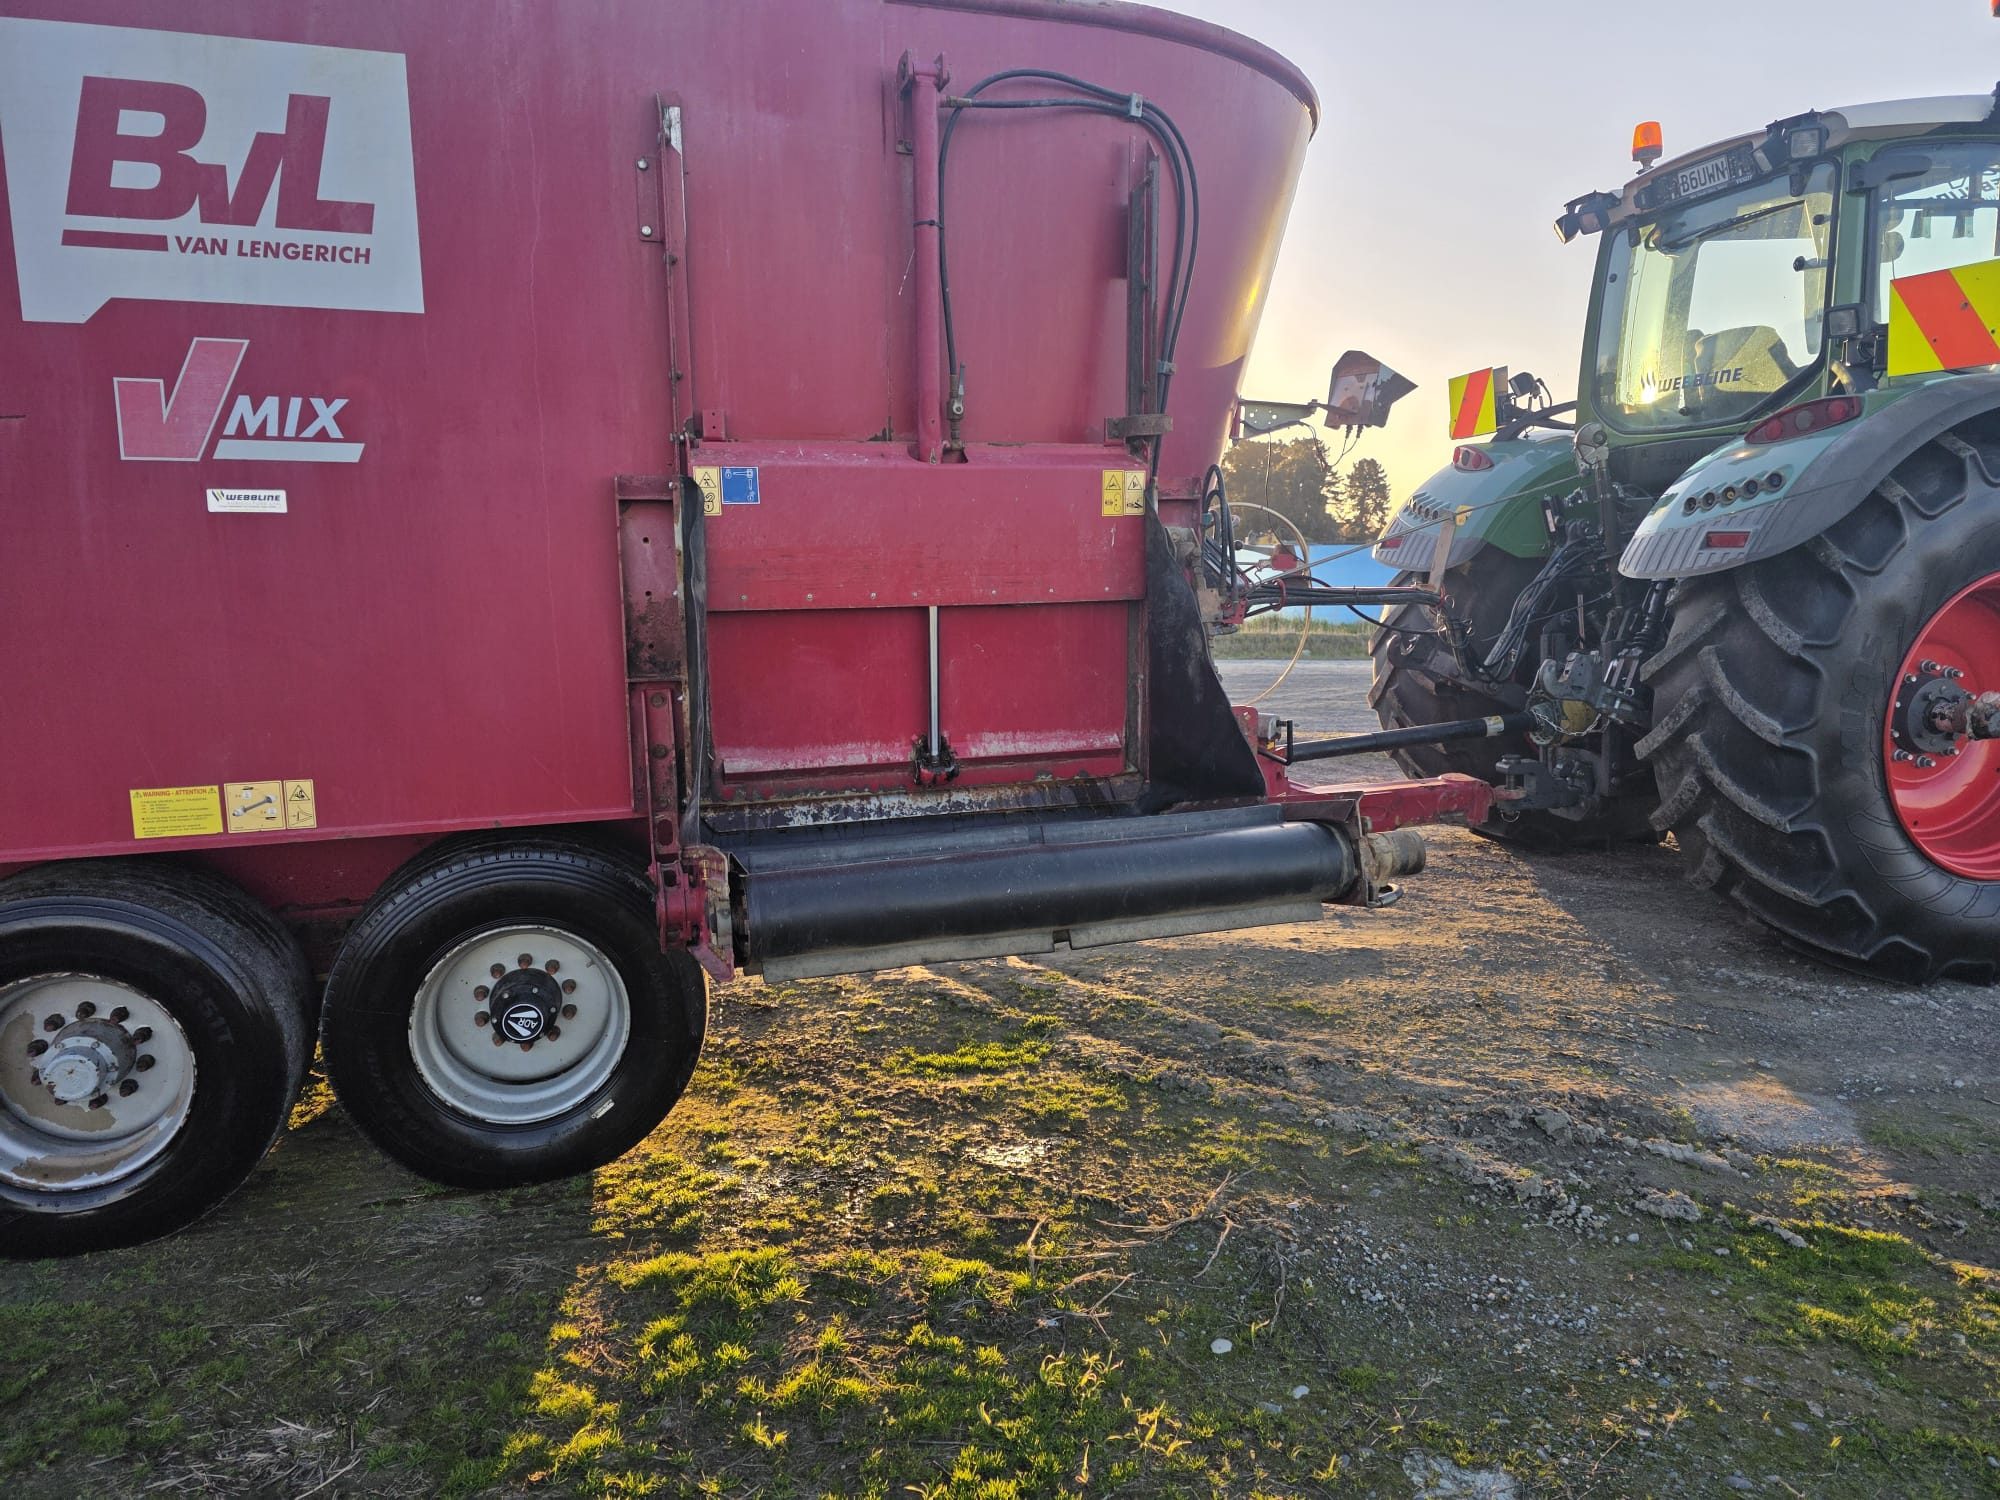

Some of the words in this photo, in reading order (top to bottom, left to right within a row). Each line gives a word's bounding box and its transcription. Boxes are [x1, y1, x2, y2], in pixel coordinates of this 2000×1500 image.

[175, 236, 228, 256] VAN
[237, 240, 371, 265] LENGERICH
[223, 395, 349, 439] MIX
[175, 788, 207, 796] ATTENTION
[518, 1017, 538, 1029] ADR
